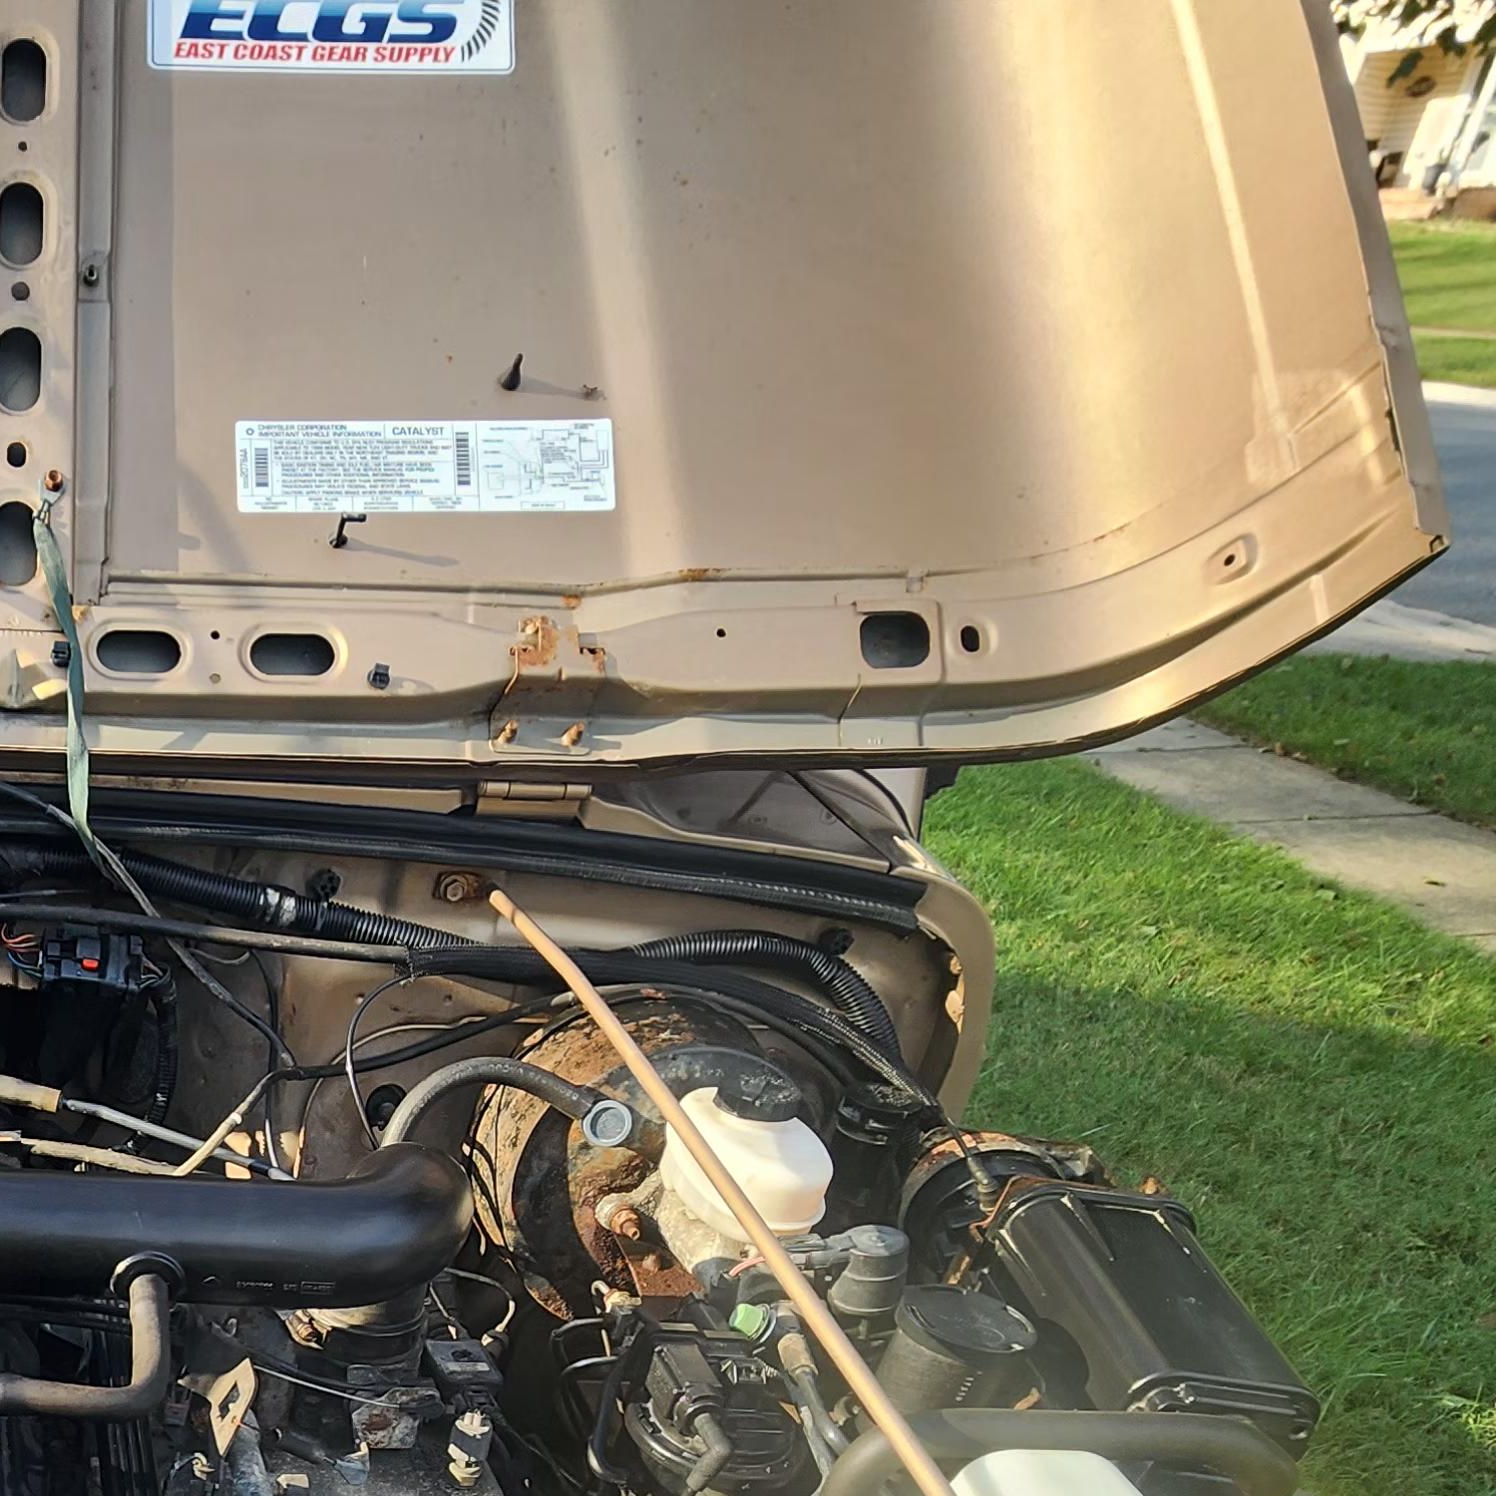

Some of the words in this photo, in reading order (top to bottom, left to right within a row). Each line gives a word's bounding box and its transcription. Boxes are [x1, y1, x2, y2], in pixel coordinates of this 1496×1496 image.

[179, 0, 459, 43] ECGS
[174, 42, 229, 60] EAST
[233, 43, 306, 62] COAST
[311, 45, 368, 63] GEAR
[373, 45, 456, 64] SUPPLY
[391, 427, 445, 437] CATALYST
